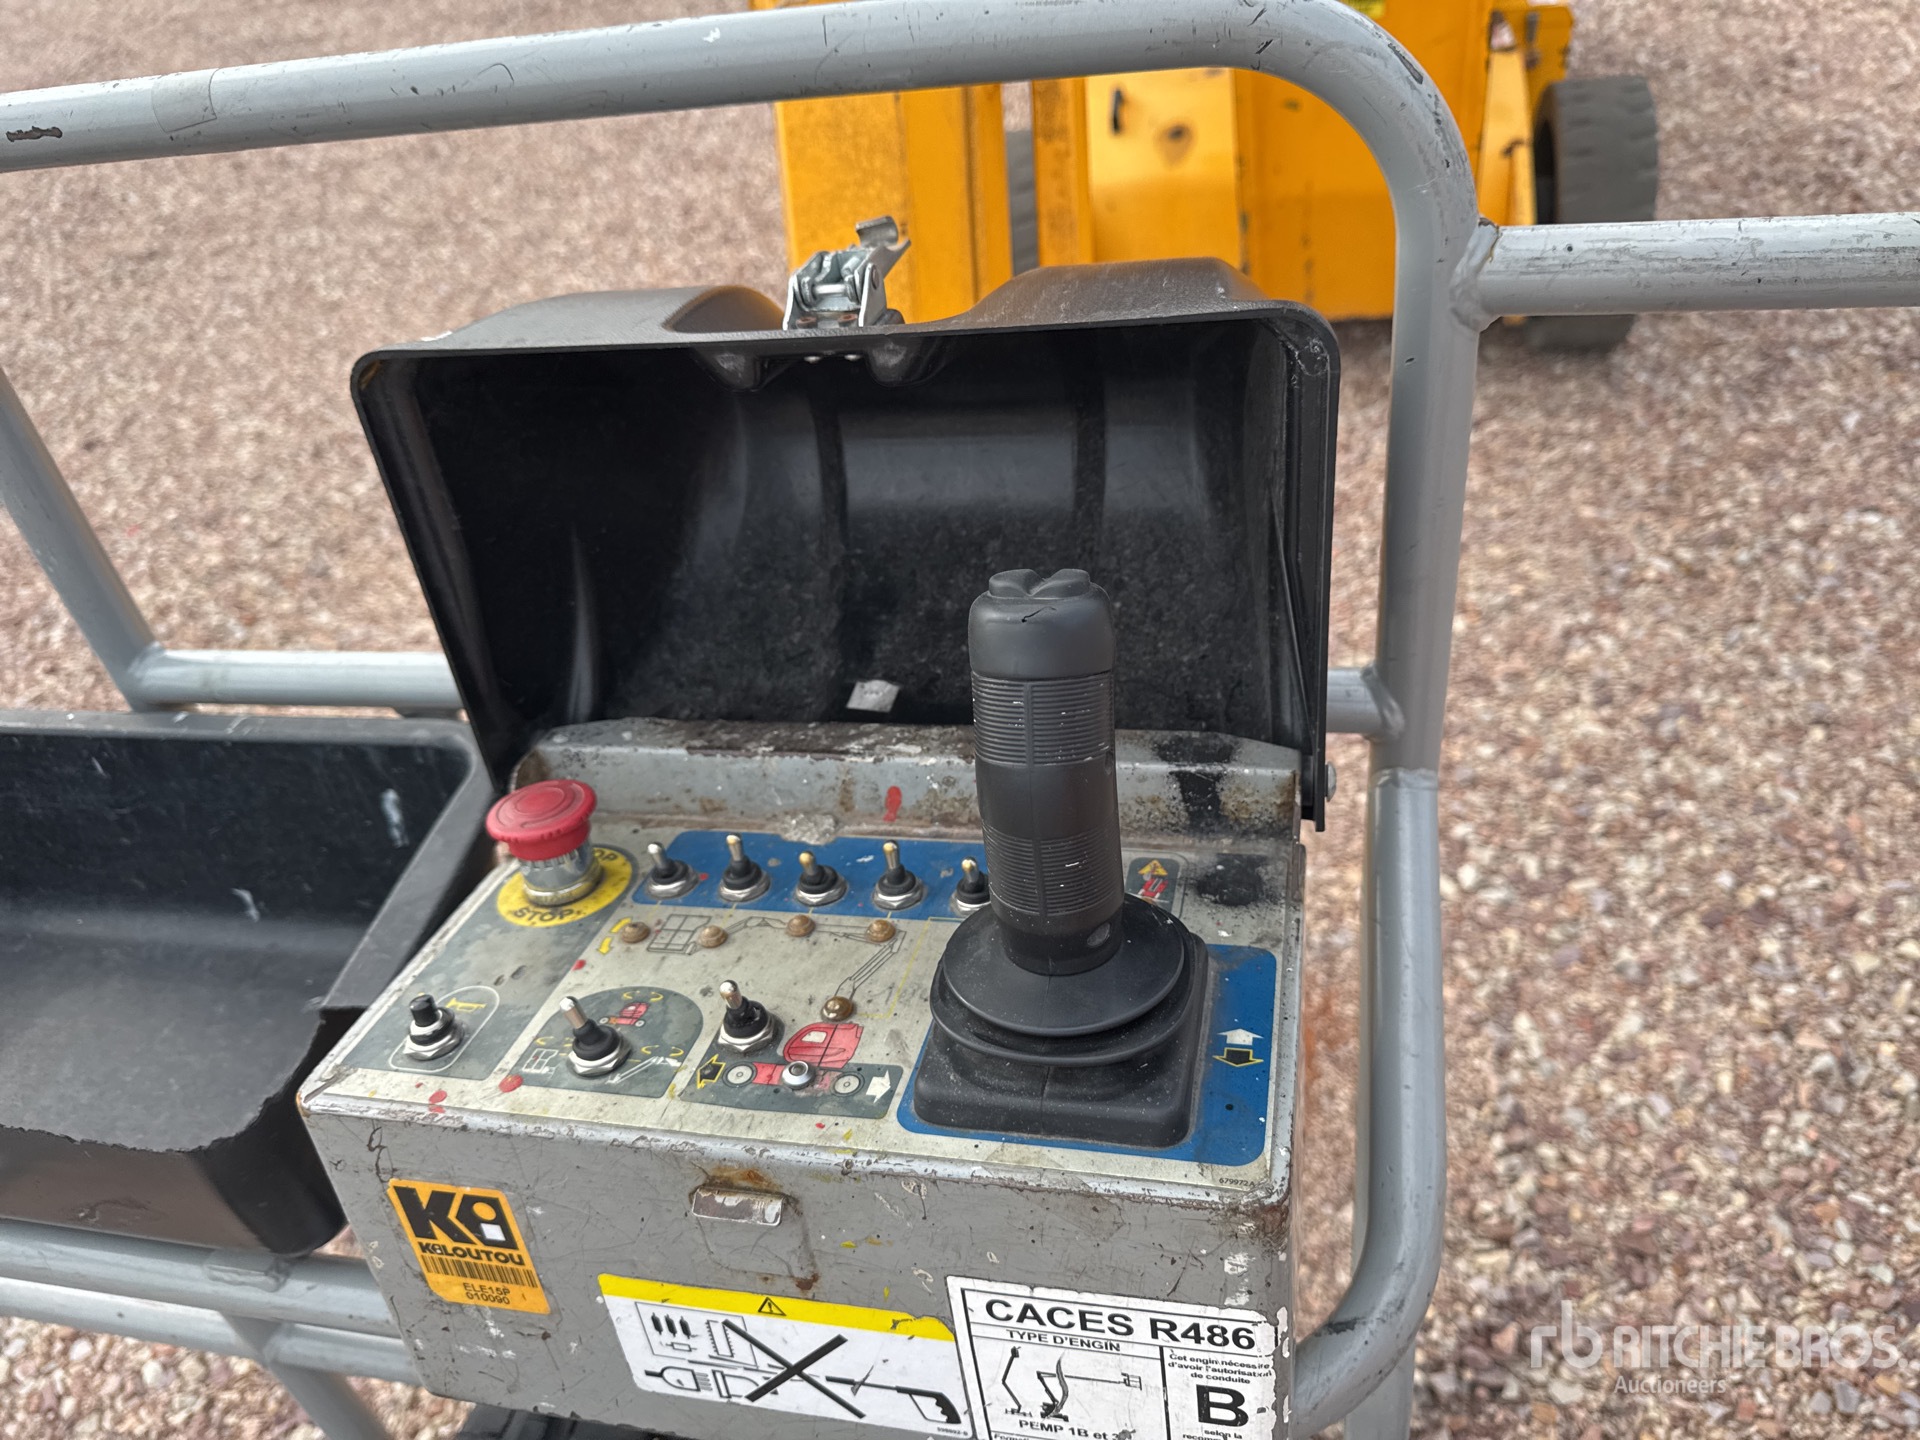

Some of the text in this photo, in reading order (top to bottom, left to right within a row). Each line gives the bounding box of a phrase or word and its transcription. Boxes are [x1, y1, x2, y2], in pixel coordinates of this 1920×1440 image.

[512, 906, 575, 923] STOP
[463, 1282, 511, 1296] ELE15P
[465, 1291, 511, 1305] 010090
[985, 1298, 1257, 1351] CACES R486
[1005, 1328, 1122, 1352] TYPE D'ENGIN
[1167, 1361, 1203, 1371] d'avoir
[1169, 1352, 1188, 1362] Cet
[1189, 1356, 1218, 1368] engin
[1190, 1371, 1251, 1385] de conduite
[1195, 1383, 1250, 1428] B
[1018, 1419, 1064, 1434] PEMP
[1068, 1426, 1089, 1438] 1B
[1093, 1432, 1109, 1440] et
[1233, 1432, 1243, 1440] la
